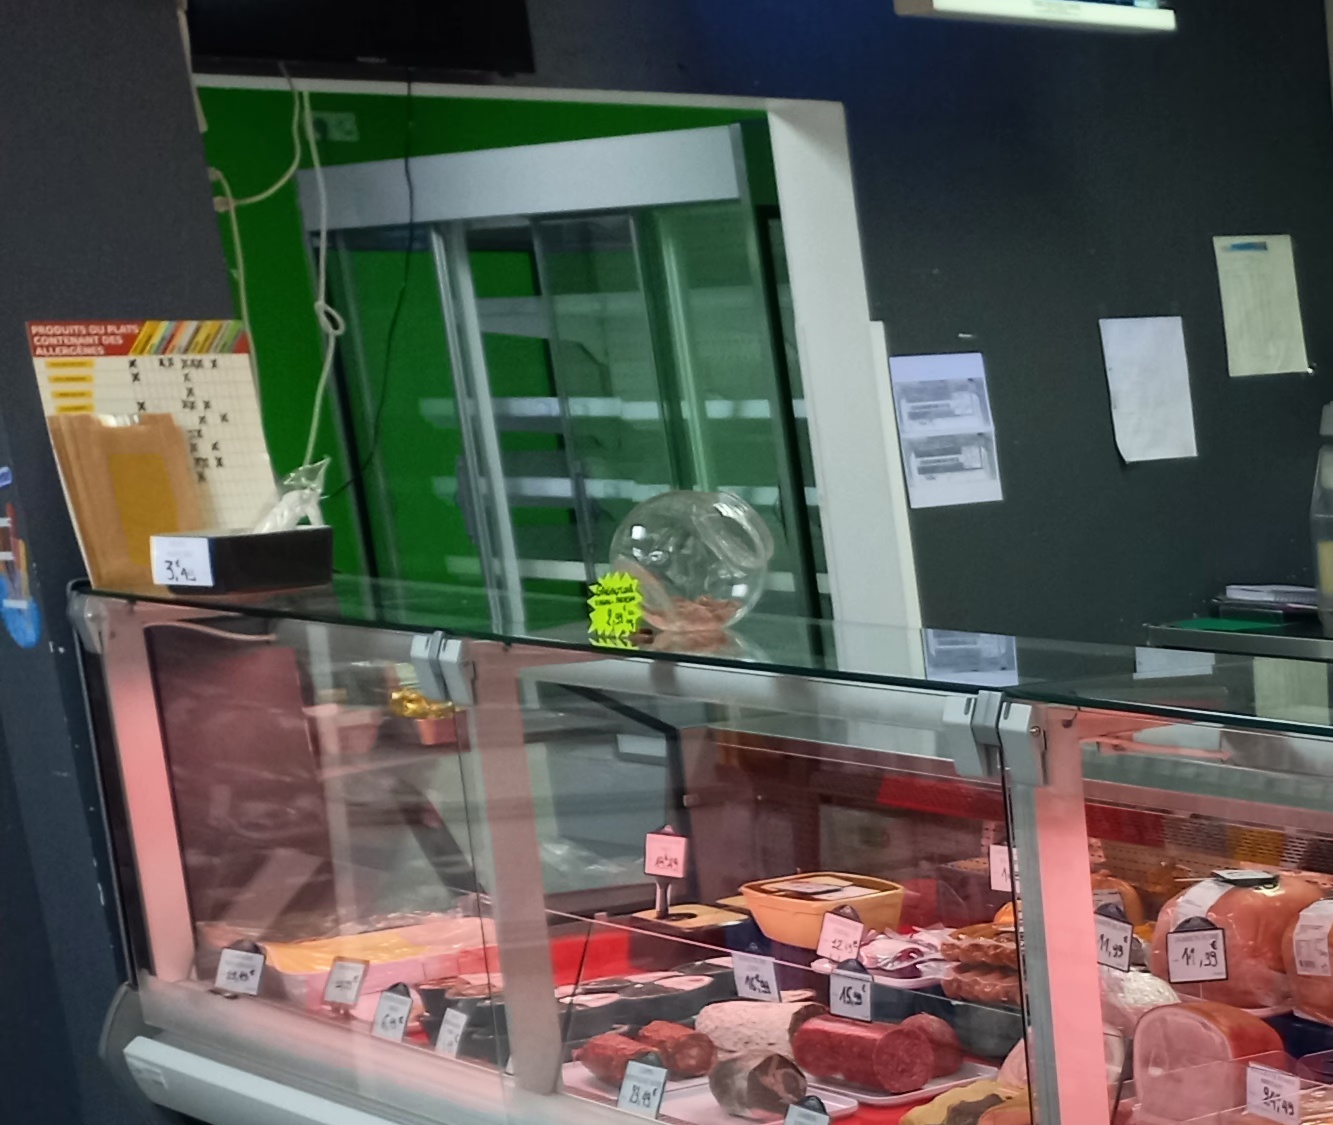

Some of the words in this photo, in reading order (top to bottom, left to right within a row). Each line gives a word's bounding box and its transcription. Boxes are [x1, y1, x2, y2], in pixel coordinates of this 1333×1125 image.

[31, 325, 86, 334] PRODUITS
[88, 325, 105, 334] OU
[107, 324, 139, 333] PLATS
[33, 335, 99, 345] CONTENANT
[102, 335, 123, 344] DES
